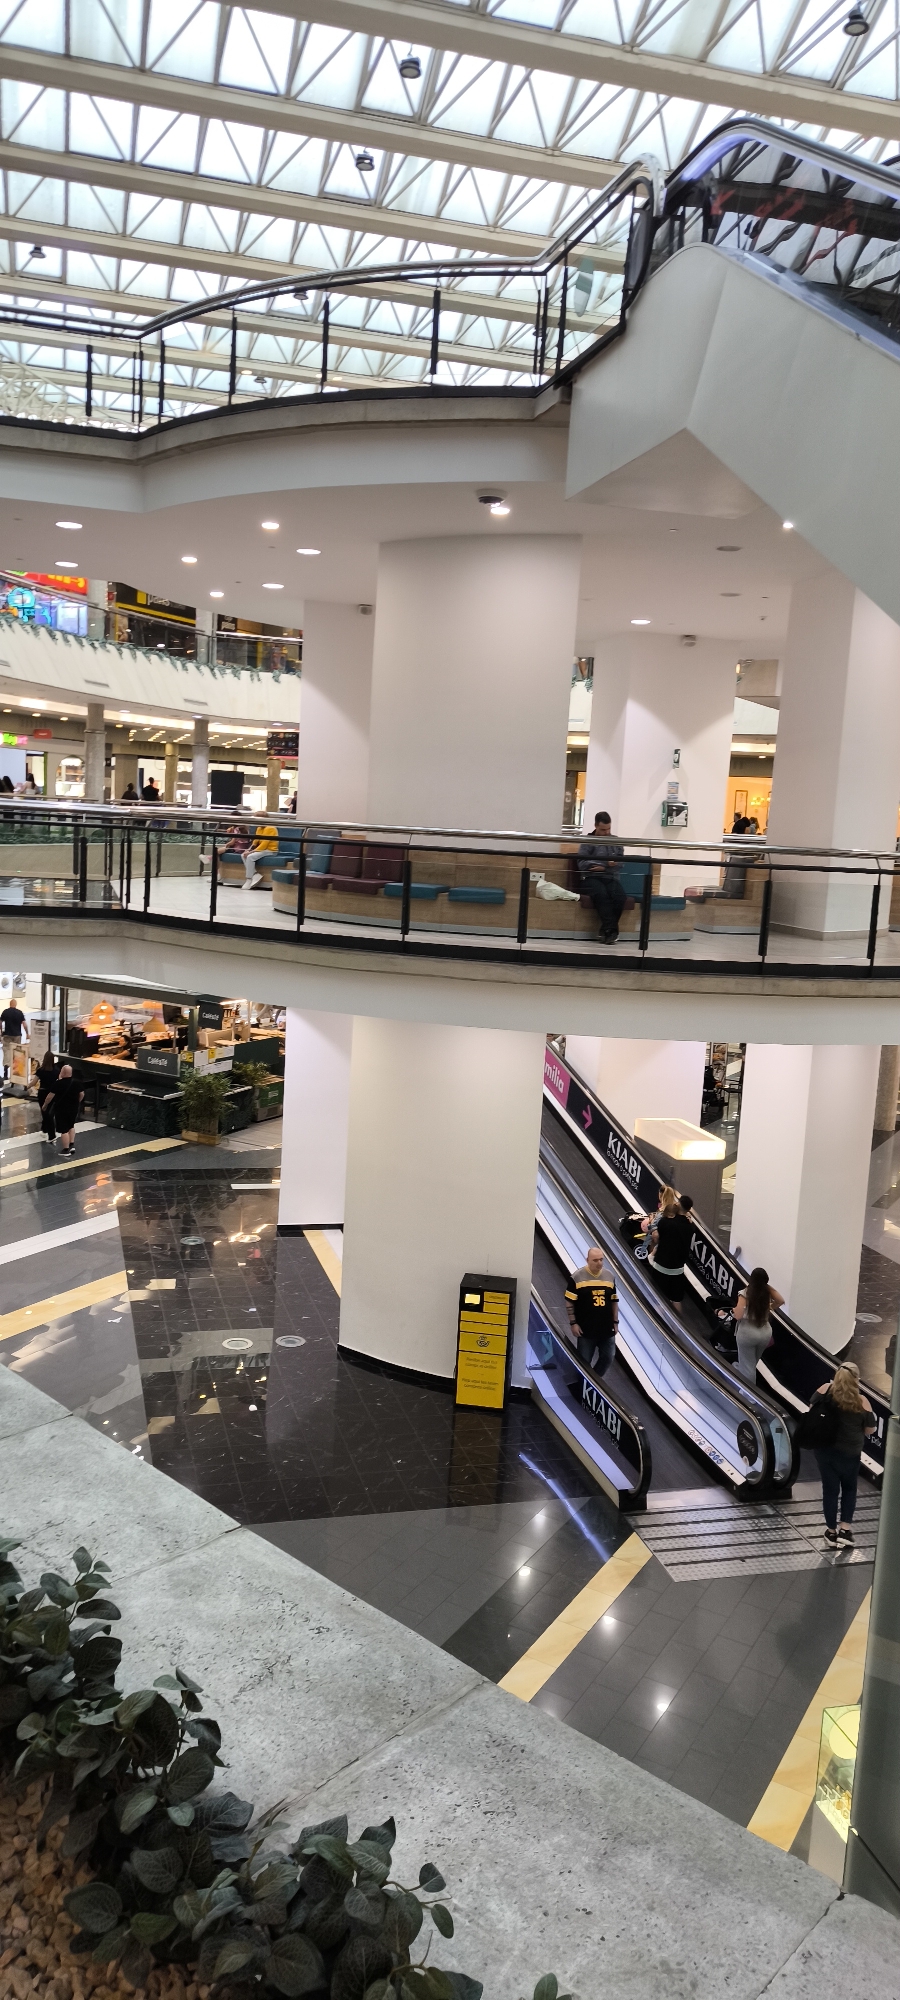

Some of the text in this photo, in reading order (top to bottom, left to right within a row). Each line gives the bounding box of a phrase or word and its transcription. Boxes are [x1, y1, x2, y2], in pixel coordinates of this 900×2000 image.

[607, 1131, 642, 1183] KIABI
[690, 1232, 735, 1298] KIABI
[593, 1295, 606, 1307] 36
[582, 1378, 622, 1441] KIABI
